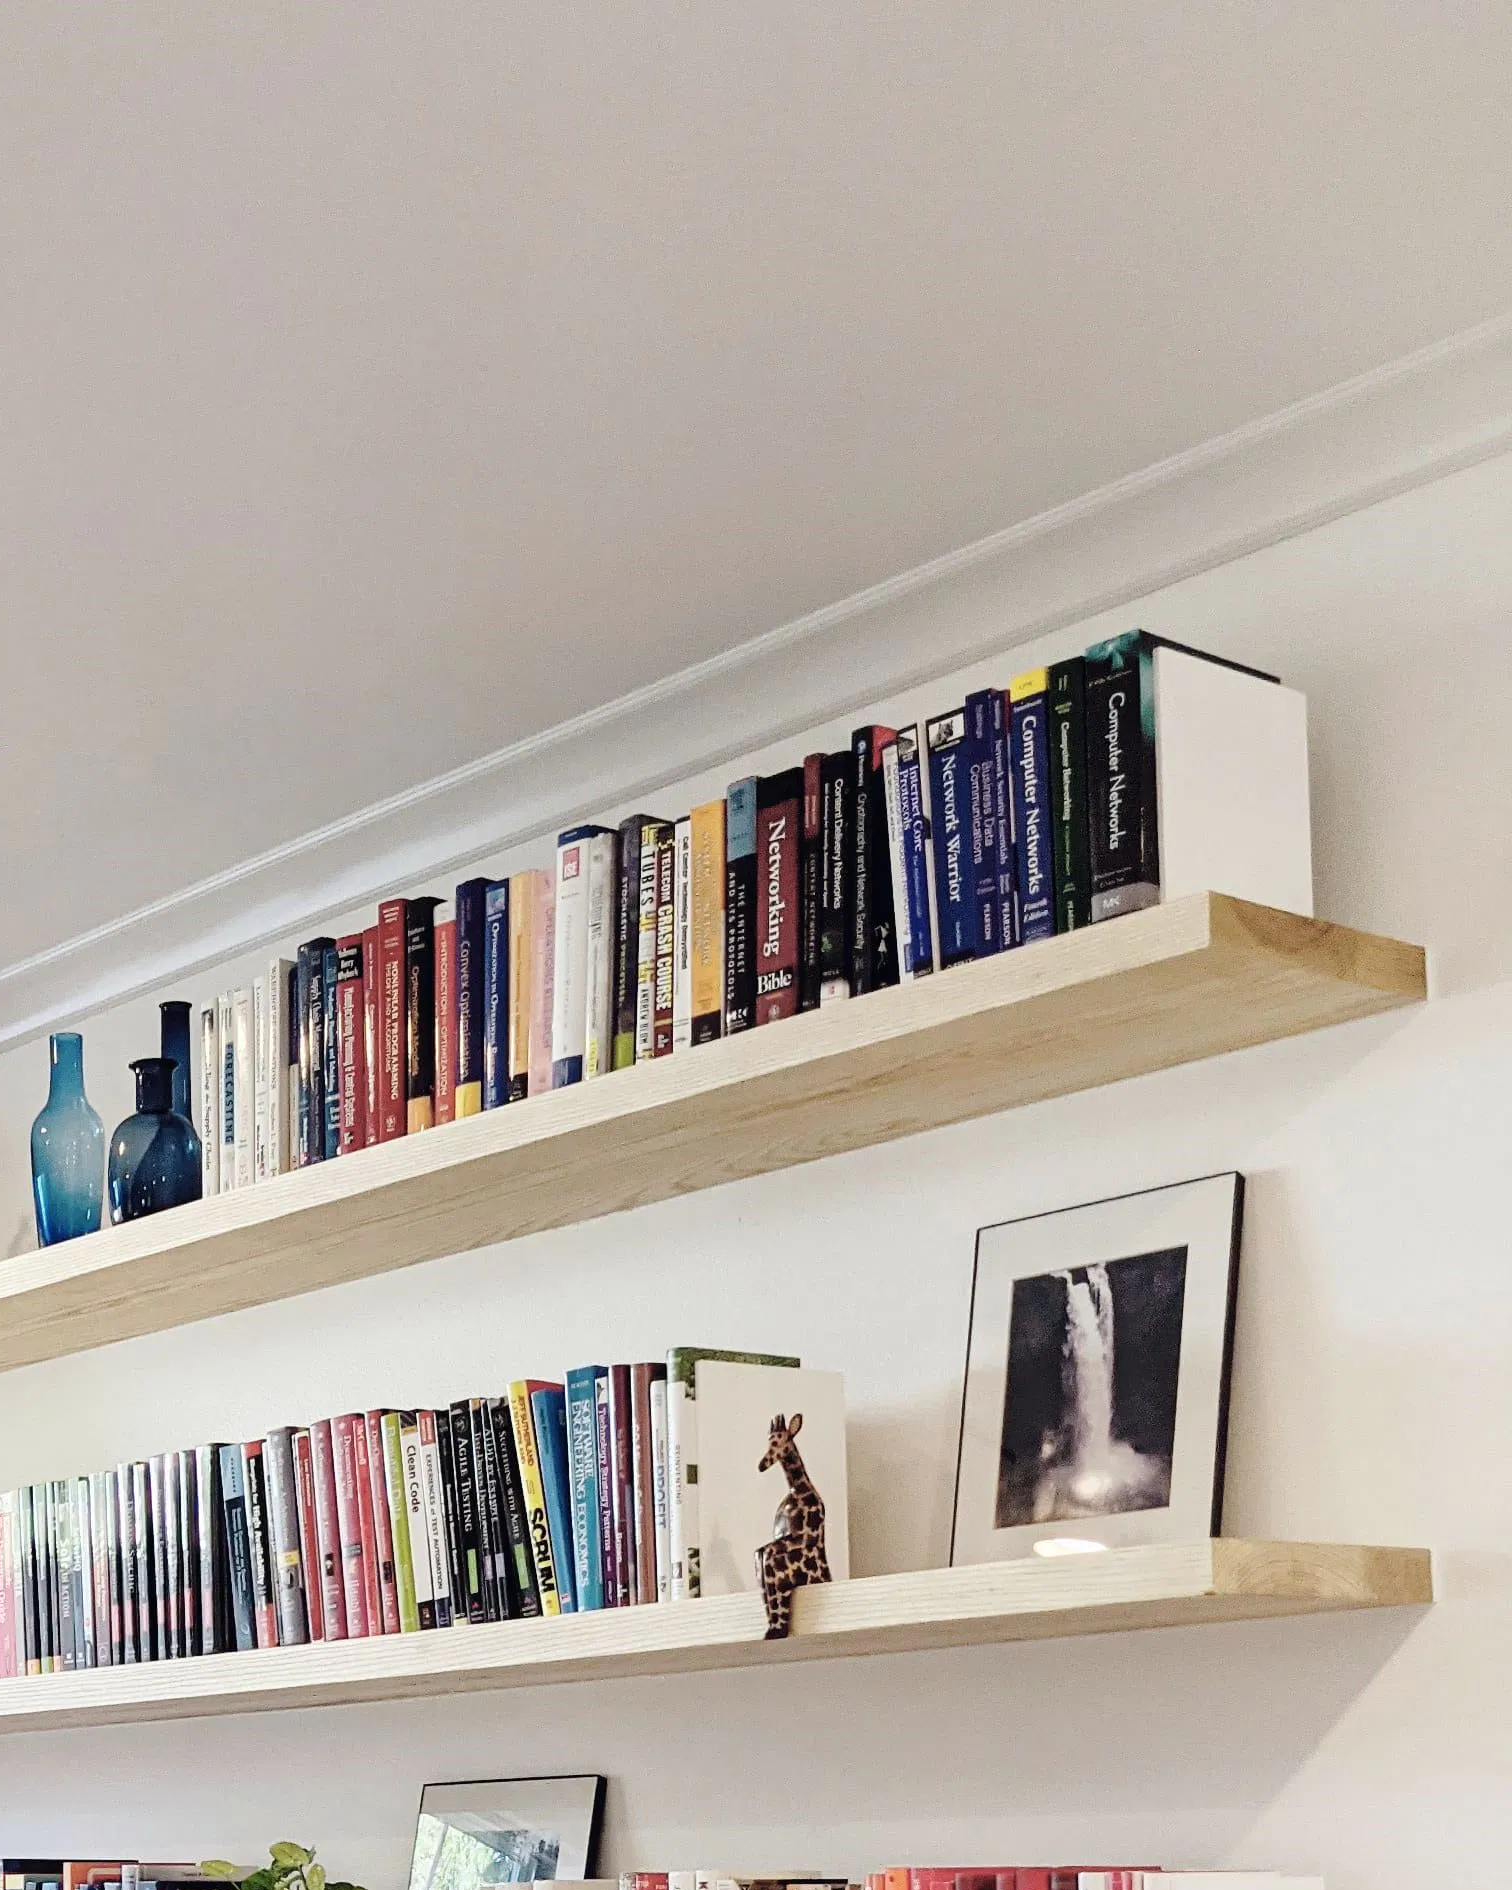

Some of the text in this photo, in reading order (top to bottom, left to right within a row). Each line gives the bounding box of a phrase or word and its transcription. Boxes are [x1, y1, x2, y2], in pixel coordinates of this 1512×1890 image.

[909, 764, 921, 817] Internet
[942, 755, 959, 833] Network
[1019, 715, 1043, 895] Computer Networks
[1105, 692, 1126, 850] Computer Networks
[832, 778, 843, 908] Content Delivery Networks
[854, 793, 866, 853] Cryptography
[913, 820, 923, 852] Core
[970, 764, 983, 864] Communications
[984, 818, 995, 846] Data
[640, 853, 655, 907] TUBES
[728, 872, 736, 896] AND
[763, 816, 786, 957] Networking
[857, 858, 866, 871] and
[946, 834, 962, 902] Warrior
[656, 850, 673, 1012] TELECOM CRASH COURSE
[728, 903, 736, 921] ITS
[737, 885, 745, 974] THE INTERNET
[854, 913, 866, 950] Security
[1002, 902, 1010, 945] PEARSON
[757, 970, 792, 994] Bible
[225, 1042, 233, 1144] FORECASTING
[390, 1022, 399, 1100] PROGRAMMING
[583, 1399, 594, 1478] SOFTWARE
[598, 1406, 608, 1465] Technology
[406, 1445, 424, 1513] Clean Code
[456, 1437, 473, 1532] AGILE TESTING
[571, 1401, 588, 1586] ENGINEERING ECONOMICS
